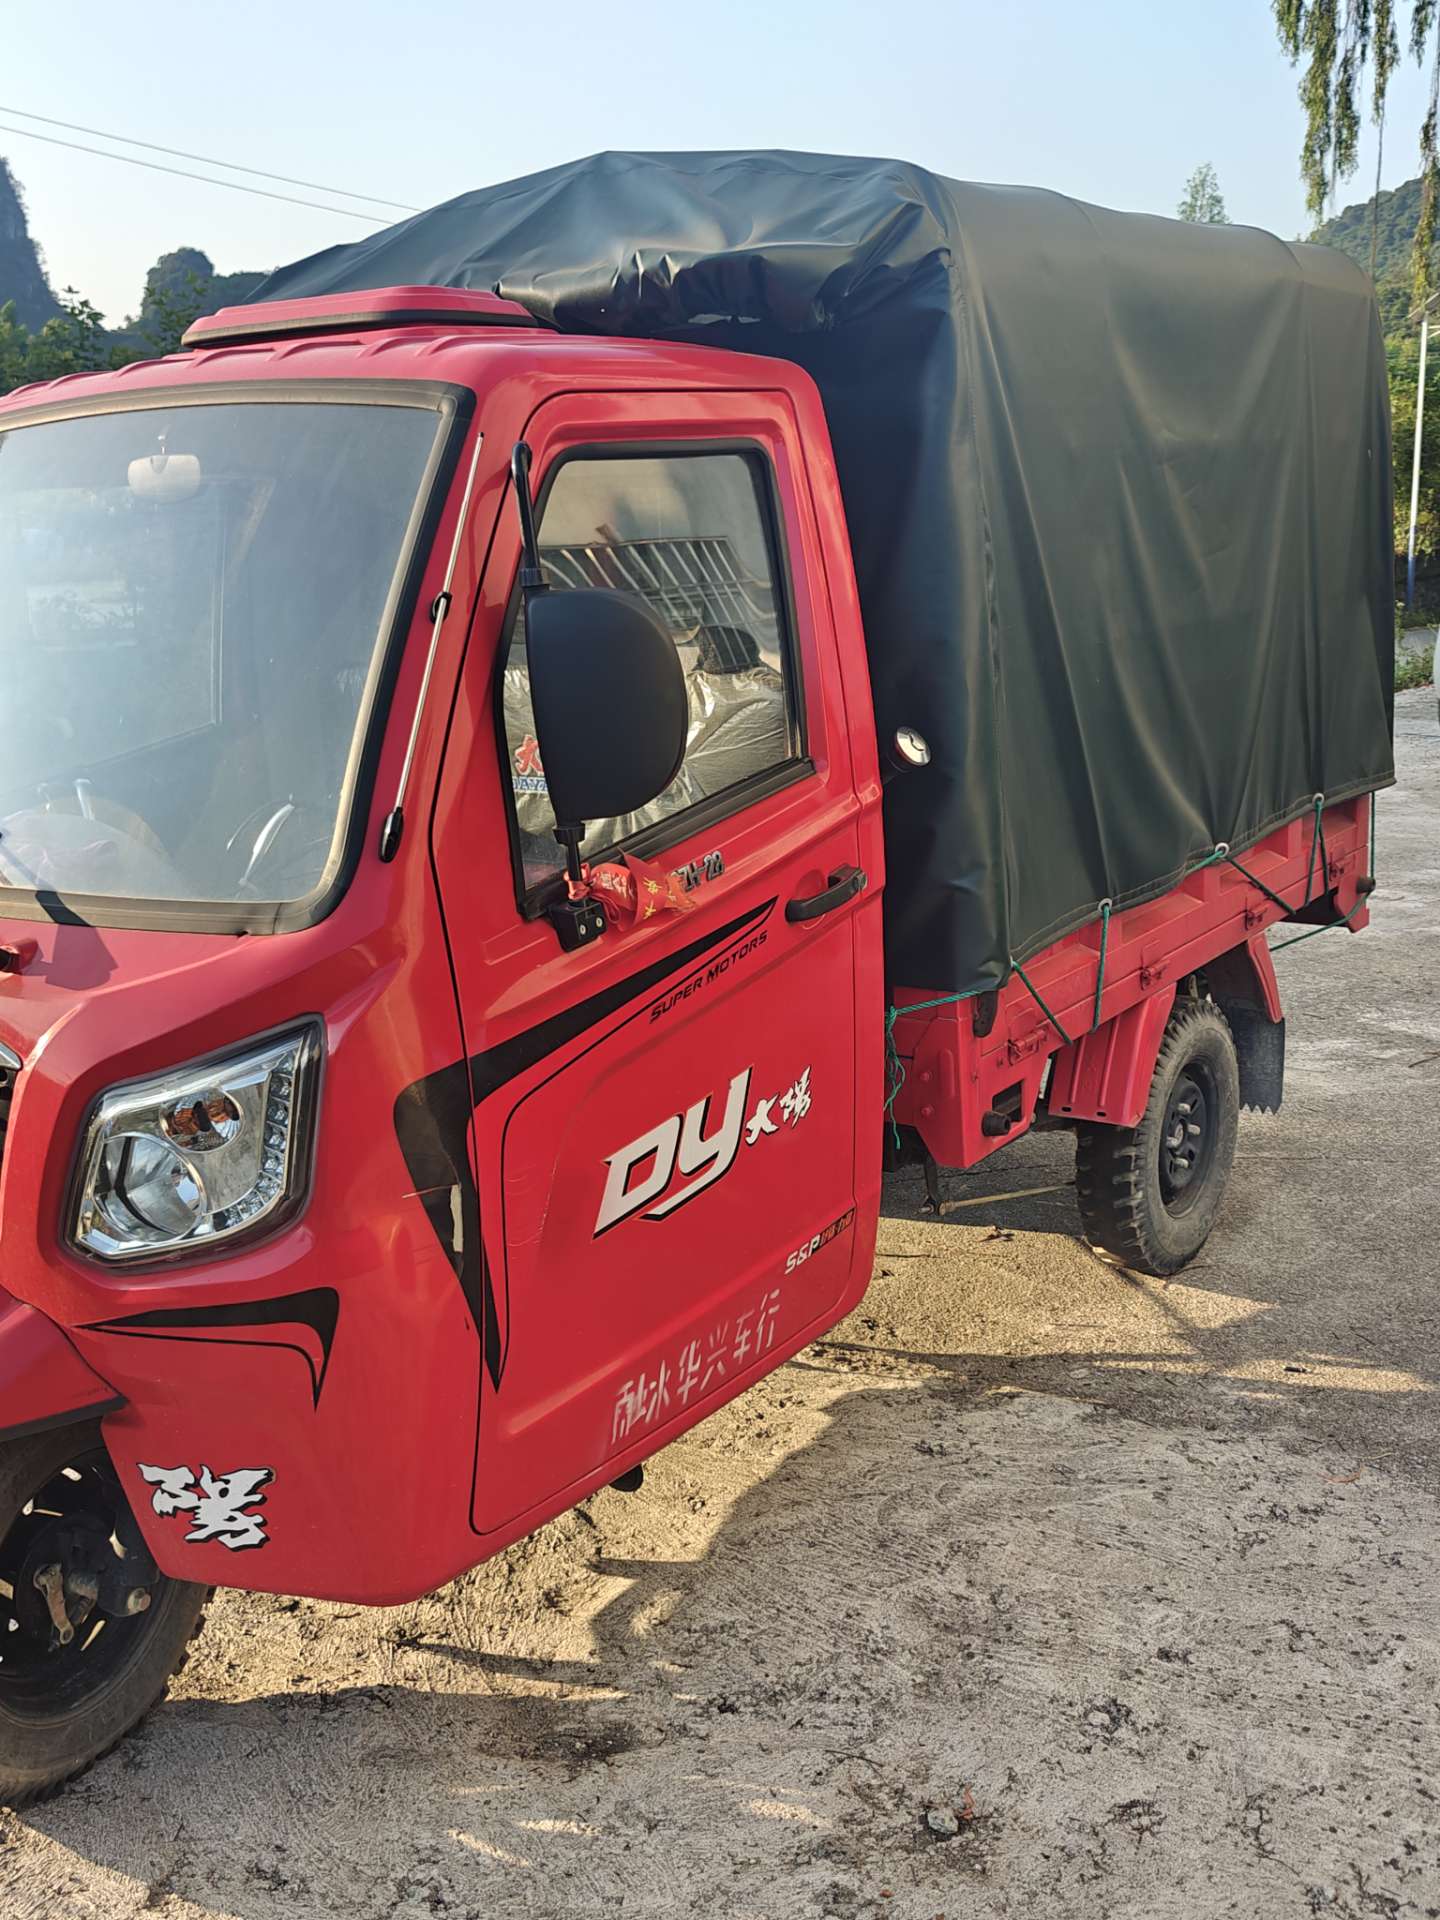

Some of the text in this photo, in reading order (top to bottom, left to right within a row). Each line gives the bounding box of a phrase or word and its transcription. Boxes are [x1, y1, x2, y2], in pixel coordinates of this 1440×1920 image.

[649, 930, 768, 1024] SUPER MOTORS
[592, 1065, 754, 1239] DY
